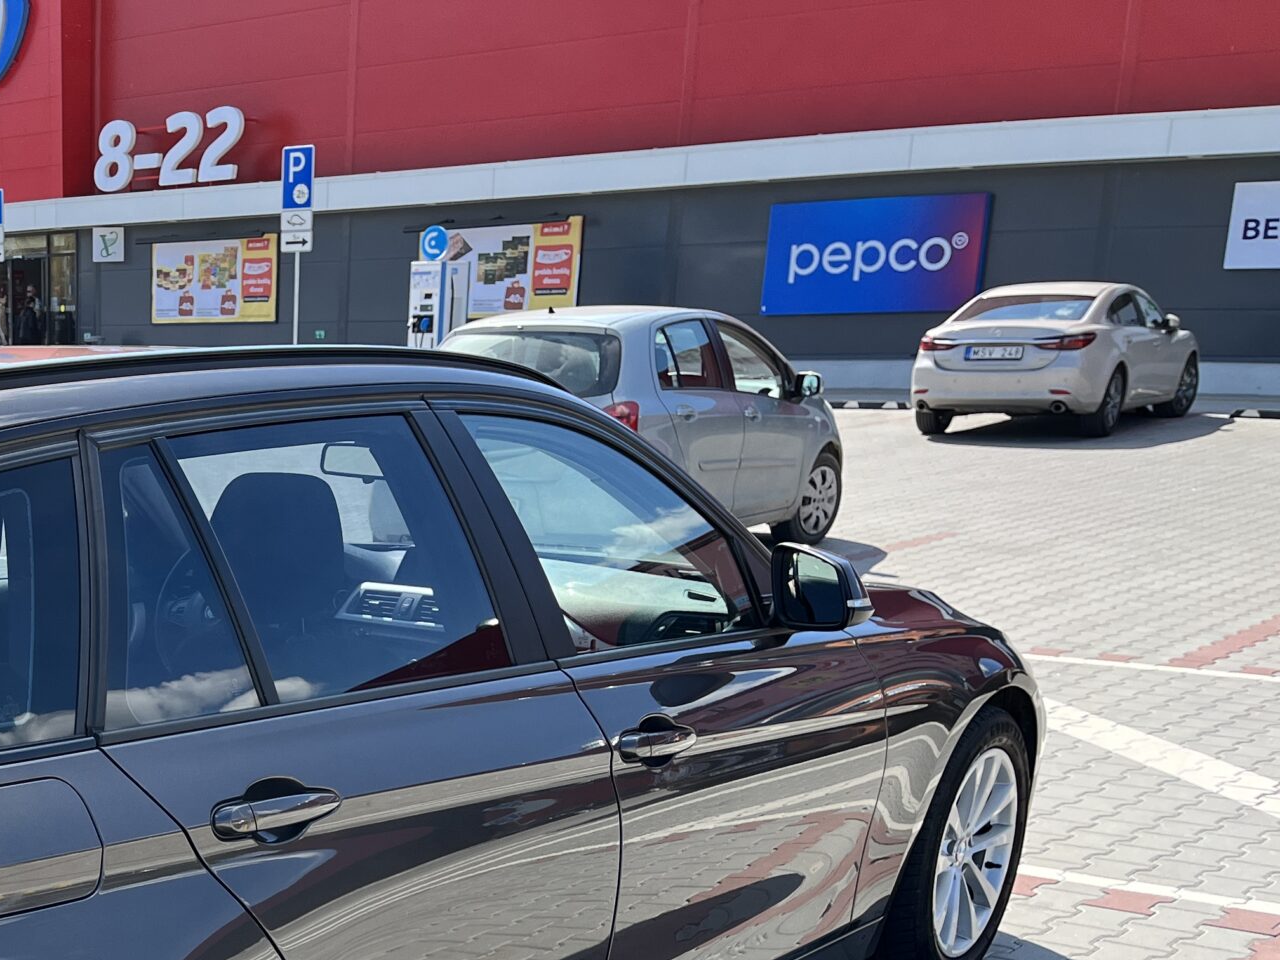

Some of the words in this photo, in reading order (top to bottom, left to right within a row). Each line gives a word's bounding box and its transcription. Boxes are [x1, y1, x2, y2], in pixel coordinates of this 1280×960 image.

[94, 105, 245, 192] 8-22
[289, 151, 306, 183] P
[787, 237, 952, 284] pepco
